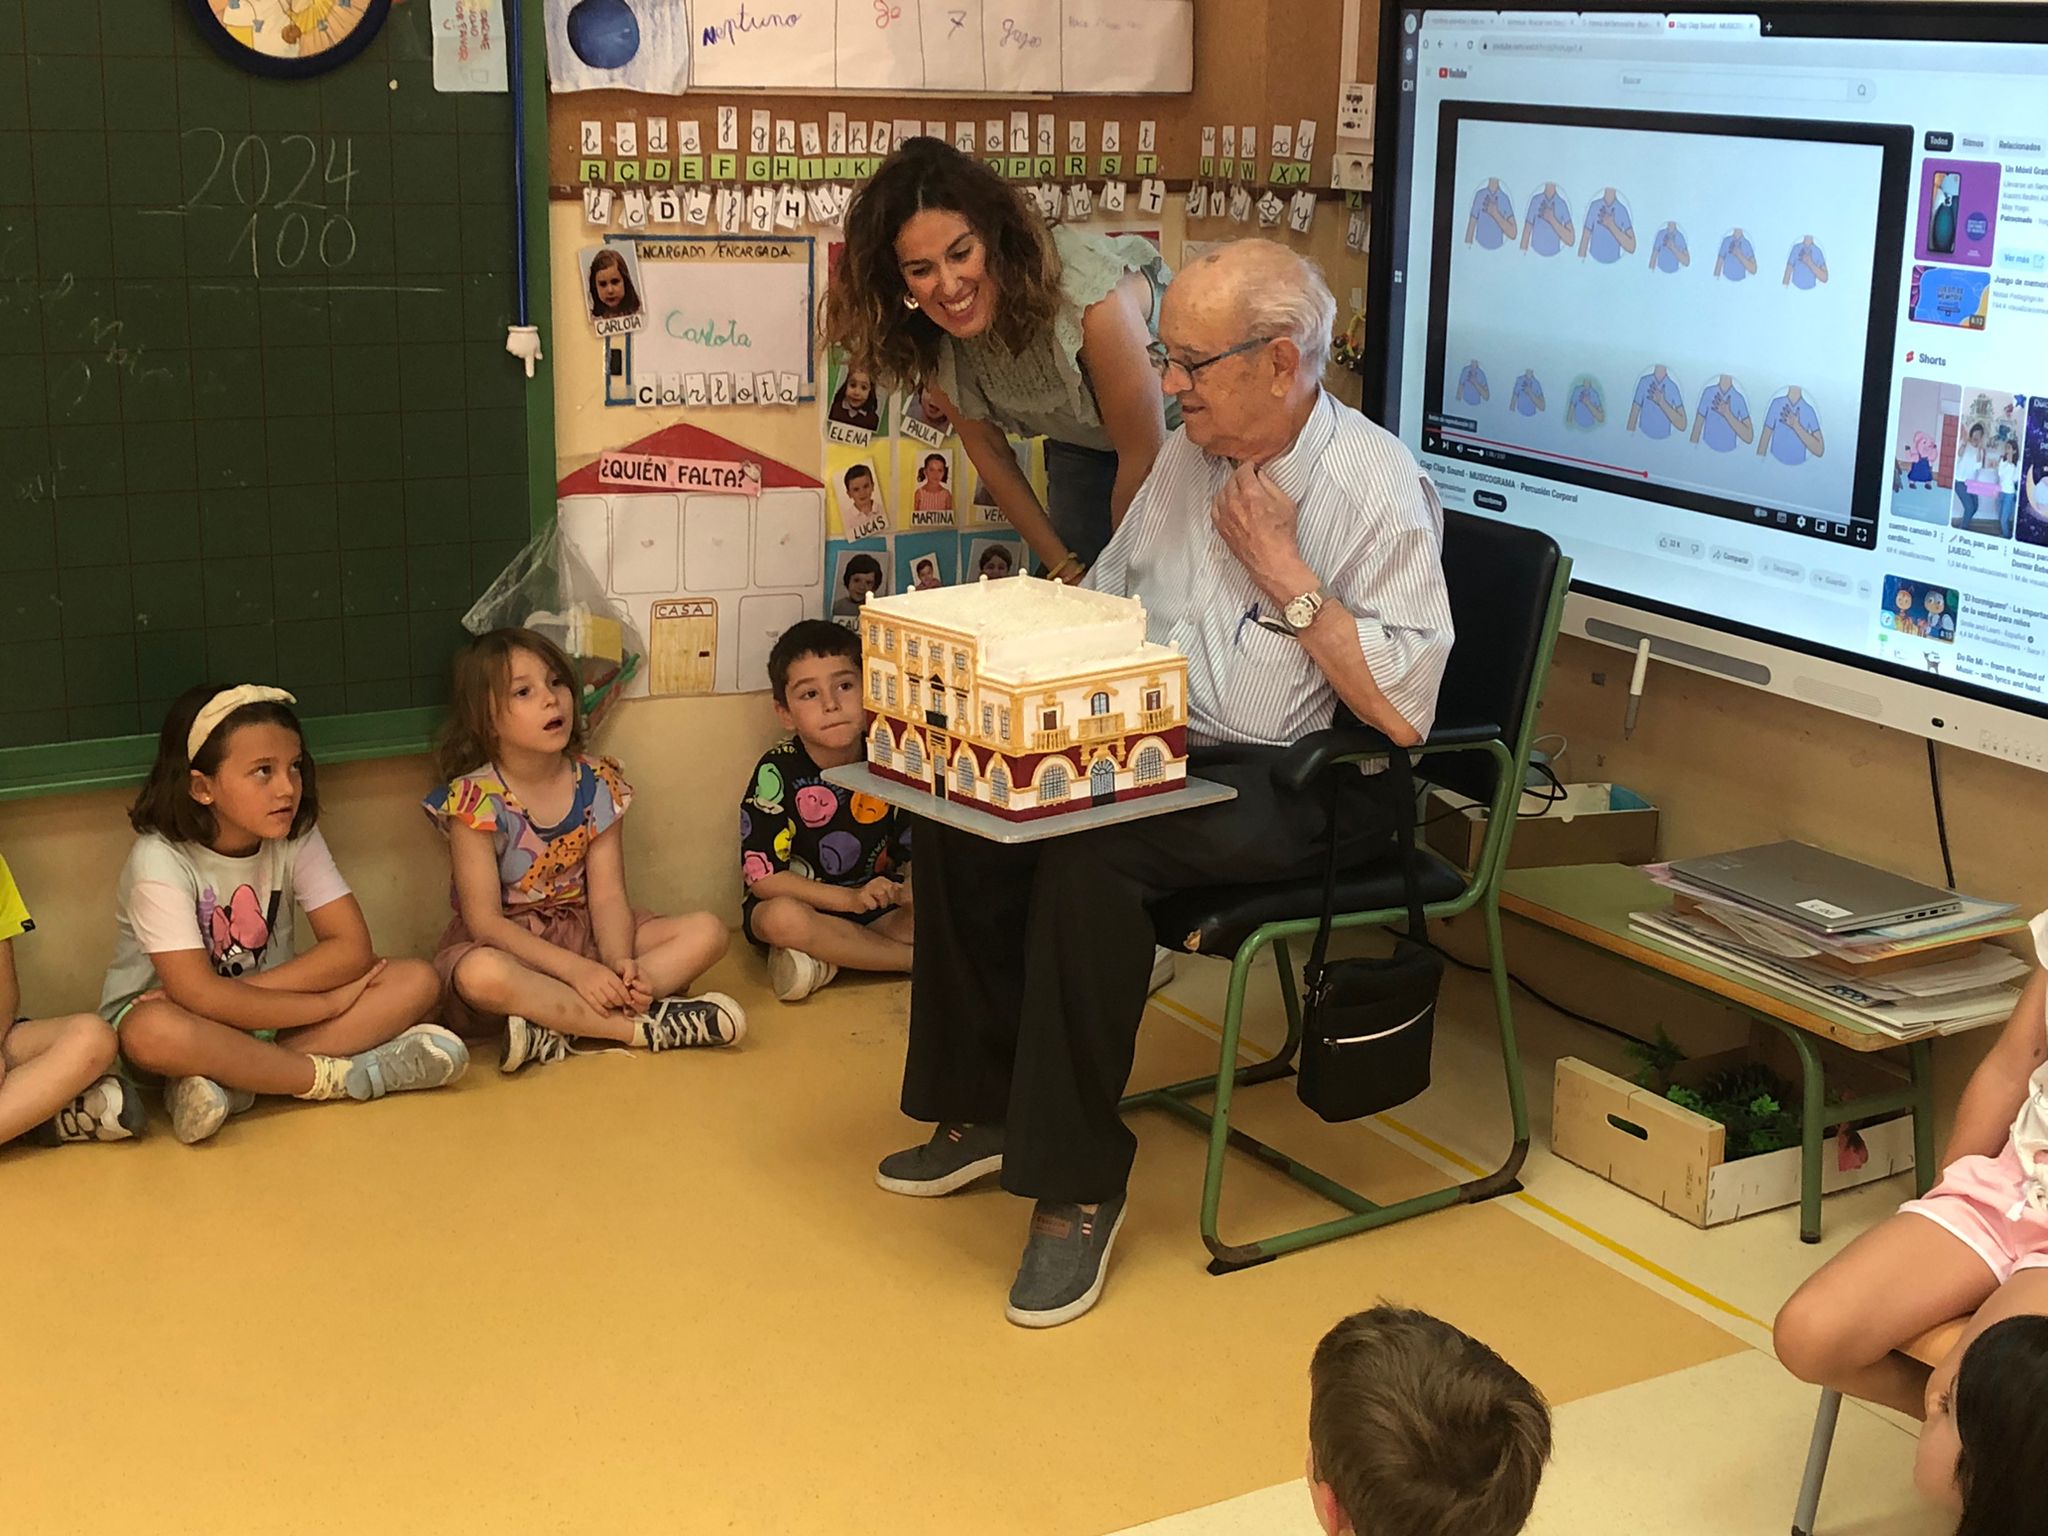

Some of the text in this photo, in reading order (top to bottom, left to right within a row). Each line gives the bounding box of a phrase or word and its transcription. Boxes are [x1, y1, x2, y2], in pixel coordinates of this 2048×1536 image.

[620, 139, 634, 152] c
[649, 126, 667, 149] d
[683, 138, 698, 151] e
[723, 109, 733, 142] f
[752, 126, 767, 150] g
[805, 135, 816, 150] i
[1930, 136, 1948, 146] Todos
[1999, 140, 2041, 151] Relacionados
[178, 127, 359, 213] 2024
[589, 164, 600, 179] B
[620, 163, 634, 180] C
[653, 163, 666, 178] D
[684, 162, 696, 179] E
[719, 159, 731, 176] F
[752, 161, 766, 176] G
[777, 159, 790, 176] H
[808, 163, 813, 178] I
[834, 162, 842, 176] J
[854, 161, 865, 175] K
[1016, 161, 1026, 176] P
[1040, 160, 1051, 175] Q
[1071, 158, 1082, 174] R
[1104, 159, 1115, 173] S
[1143, 158, 1153, 173] T
[1202, 163, 1211, 176] U
[1242, 163, 1254, 178] W
[1277, 167, 1290, 182] X
[1296, 167, 1308, 182] Y
[661, 201, 674, 219] D
[753, 205, 768, 228] g
[786, 200, 799, 217] H
[1149, 193, 1160, 210] T
[228, 212, 356, 278] 100
[2004, 254, 2014, 262] Ver
[597, 316, 641, 335] CARLOTA
[1919, 353, 1946, 366] Shorts
[830, 426, 869, 447] ELENA
[906, 420, 938, 444] PAULA
[601, 458, 745, 488] ¿QUIÉN FALTA?
[1420, 460, 1432, 471] Clap
[1433, 463, 1446, 473] Clap
[1447, 466, 1465, 477] Sound
[1469, 471, 1515, 488] MUSICOGRAMA
[1520, 483, 1550, 496] Percusión
[1552, 489, 1578, 502] Corporal
[853, 516, 886, 540] LUCAS
[912, 512, 954, 525] MARTINA
[658, 605, 704, 616] CASA
